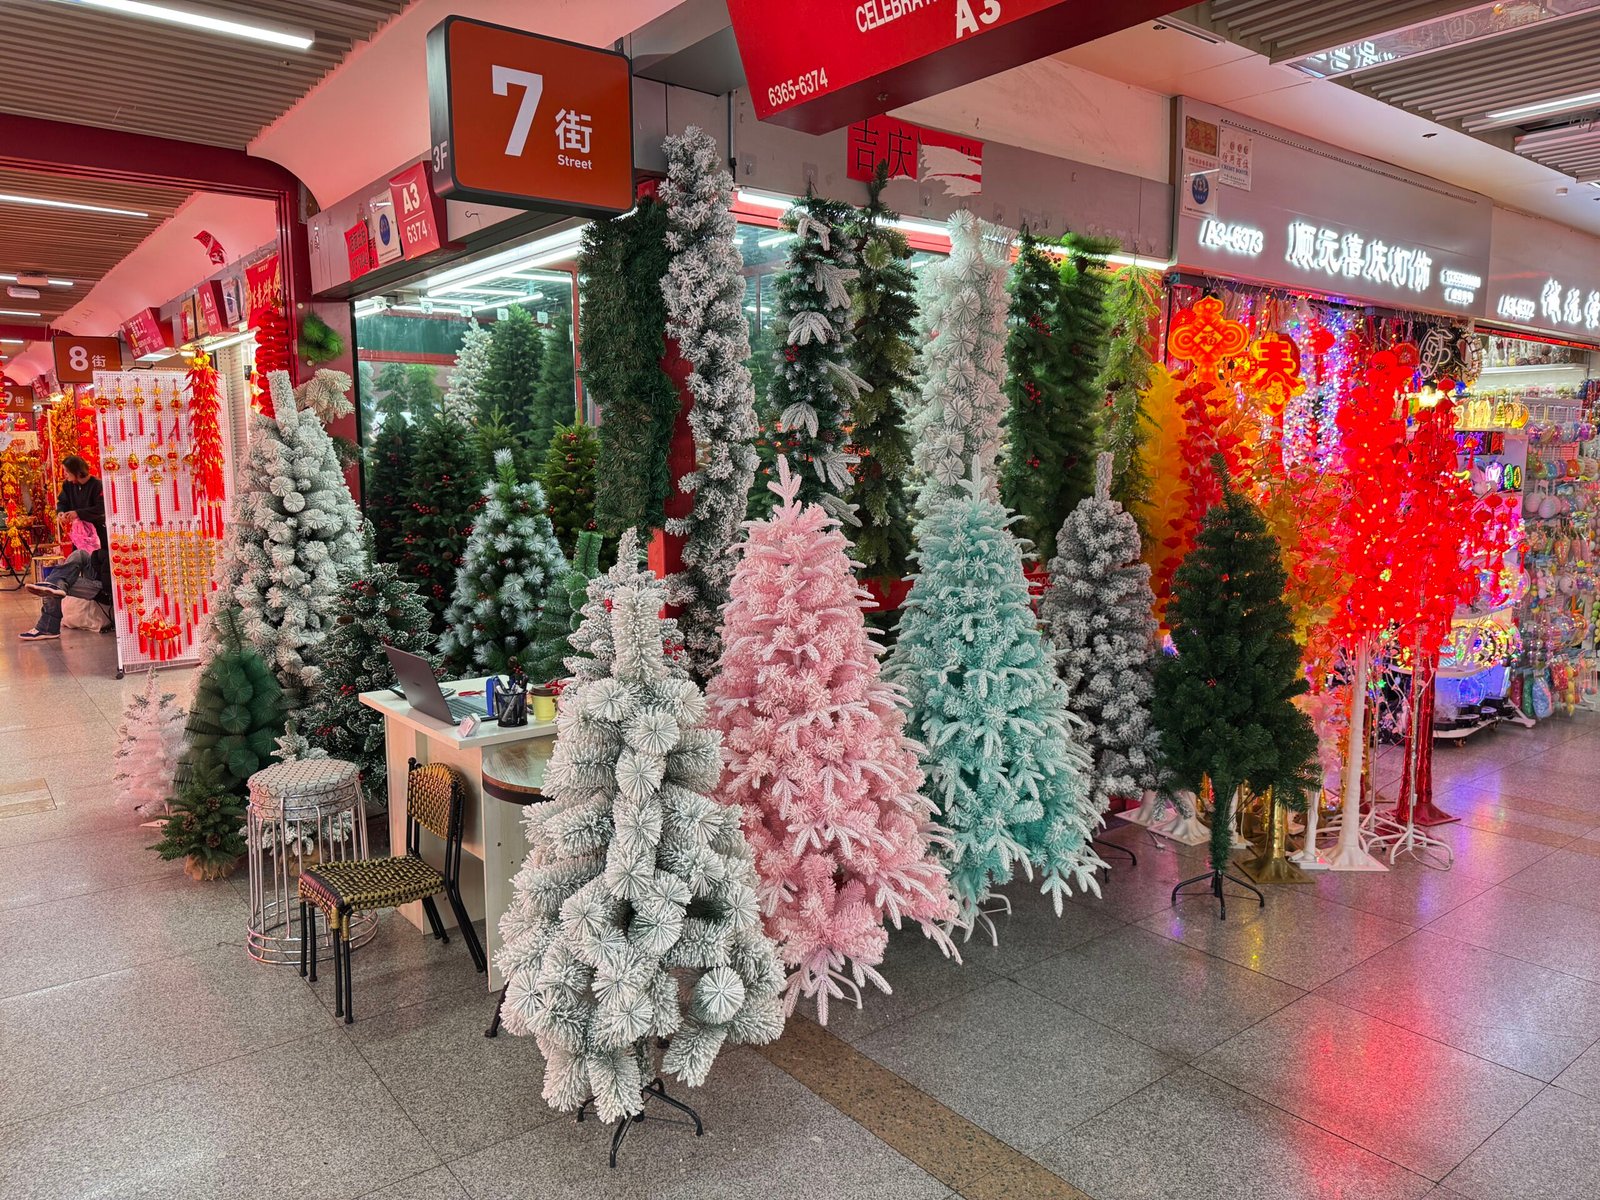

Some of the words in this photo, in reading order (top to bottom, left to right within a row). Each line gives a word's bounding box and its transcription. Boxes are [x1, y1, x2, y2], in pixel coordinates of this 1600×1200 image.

[955, 0, 1001, 39] A3
[768, 67, 828, 107] 6365-6374
[491, 65, 543, 157] 7
[555, 108, 593, 154] 街
[433, 141, 448, 173] 3F
[557, 154, 593, 170] Street
[402, 182, 421, 215] A3
[406, 219, 428, 245] 6374
[69, 345, 89, 371] 8
[92, 354, 107, 368] 街
